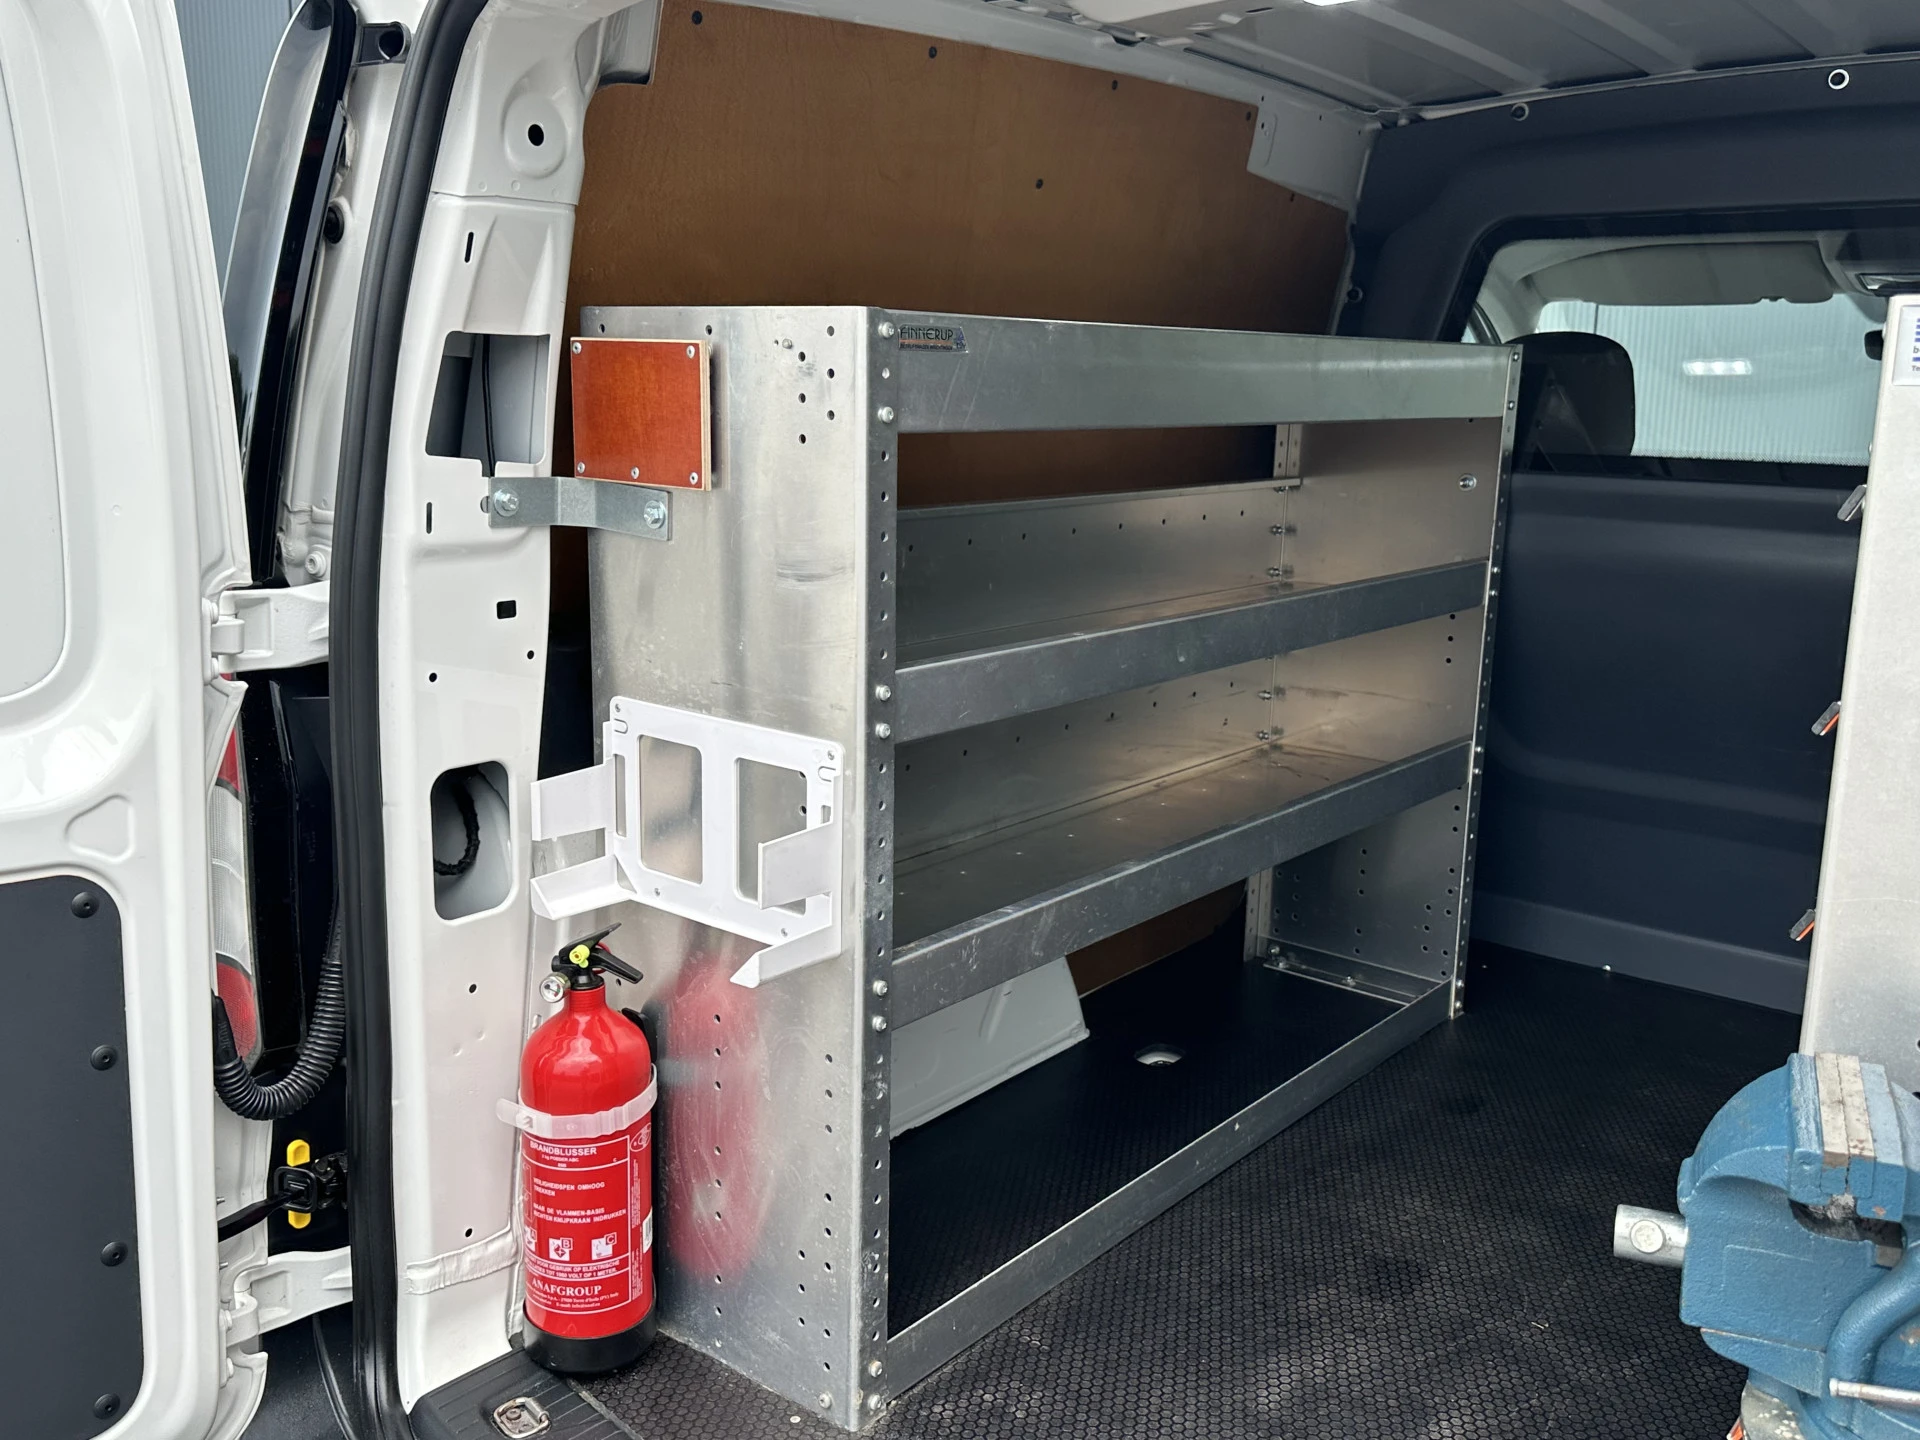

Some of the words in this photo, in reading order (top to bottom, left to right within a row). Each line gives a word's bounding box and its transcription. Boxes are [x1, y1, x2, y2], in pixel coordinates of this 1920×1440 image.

[900, 327, 954, 341] FINNERUP
[530, 1141, 597, 1156] BRANDBLUSSER
[577, 1181, 606, 1191] OMHOOG
[553, 1215, 591, 1224] KNIJPKRAAN
[593, 1208, 627, 1223] INDRUKKEN
[556, 1207, 606, 1217] VLAMMEN-BASIS
[563, 1239, 571, 1249] B
[606, 1234, 615, 1244] C
[531, 1277, 602, 1297] ANAFGROUP
